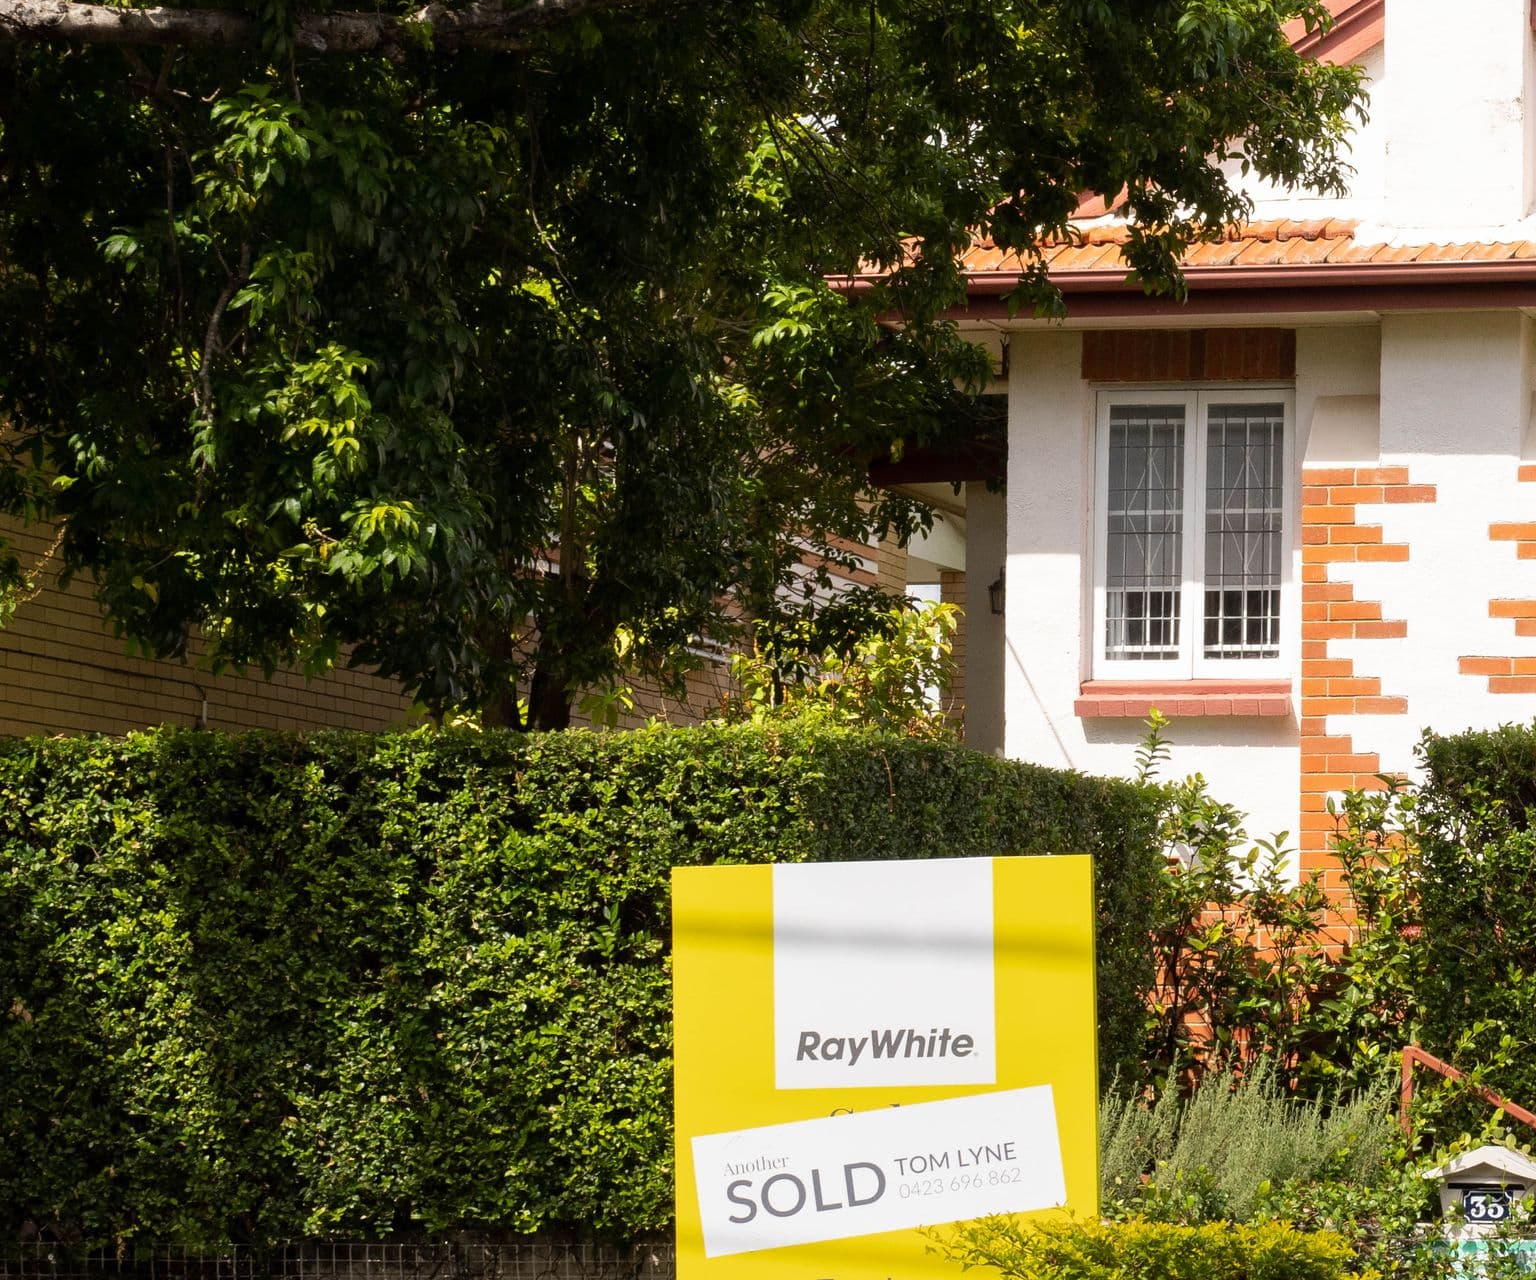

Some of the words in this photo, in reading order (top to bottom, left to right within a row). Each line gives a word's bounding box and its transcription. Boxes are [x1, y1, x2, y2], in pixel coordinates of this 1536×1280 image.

[723, 1154, 790, 1178] Another
[894, 1150, 950, 1176] TOM
[957, 1141, 1017, 1167] LYNE
[726, 1161, 886, 1225] SOLD
[899, 1177, 944, 1199] 0423
[951, 1171, 983, 1192] 696
[989, 1166, 1023, 1187] 862
[1470, 1196, 1505, 1219] 35
